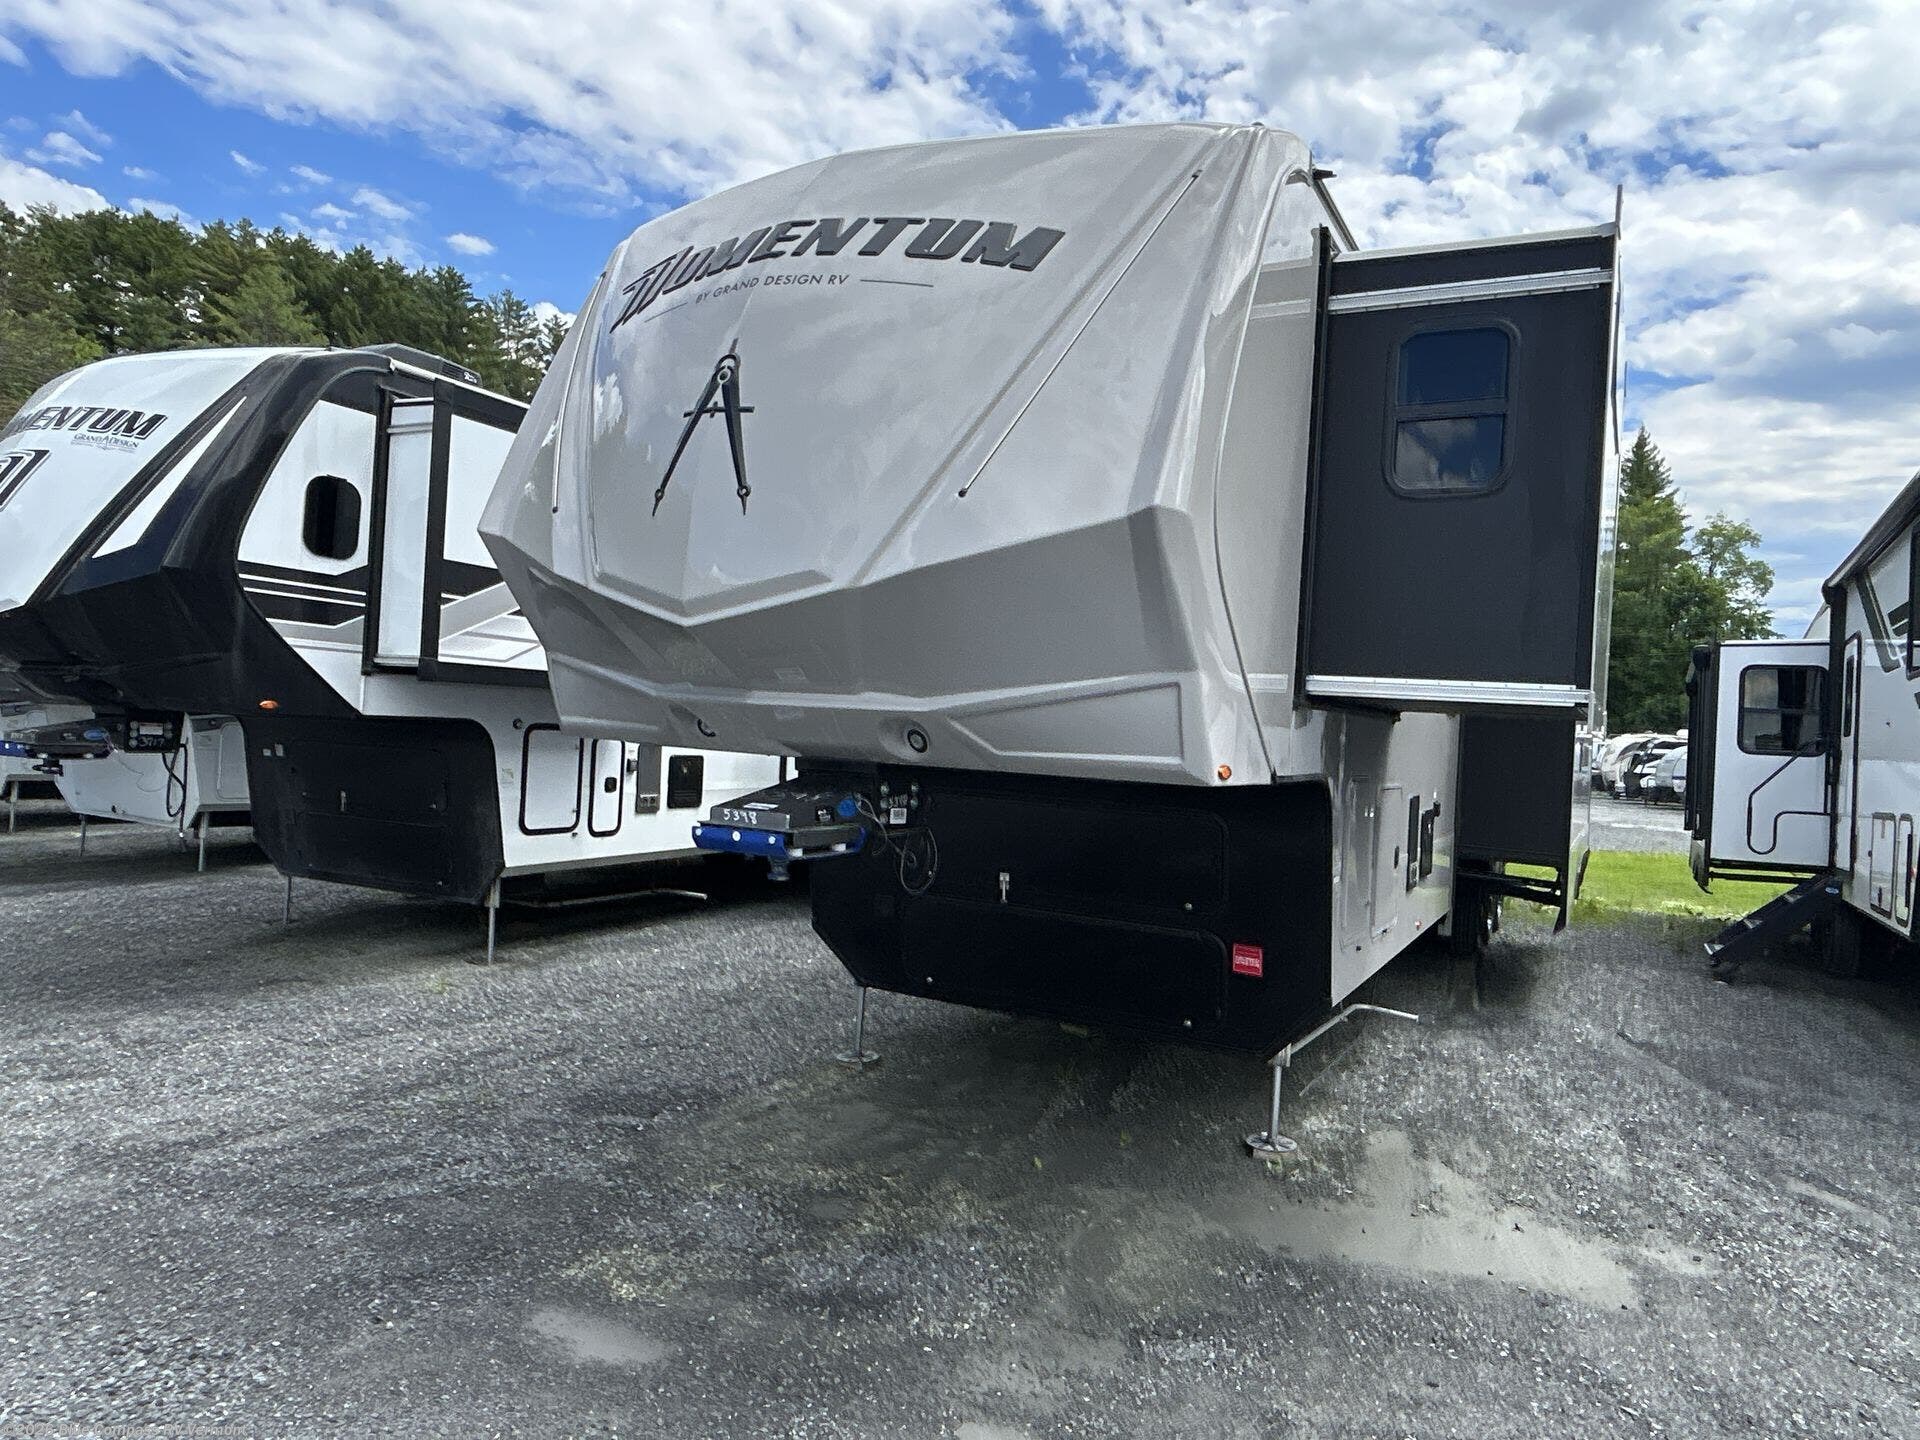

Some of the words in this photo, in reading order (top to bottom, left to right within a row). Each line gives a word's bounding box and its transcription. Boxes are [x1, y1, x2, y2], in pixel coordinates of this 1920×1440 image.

[609, 216, 1066, 334] MOMENTUM
[695, 291, 712, 304] BY
[713, 277, 760, 298] GRAND
[763, 274, 824, 286] DESIGN
[827, 274, 850, 285] RV
